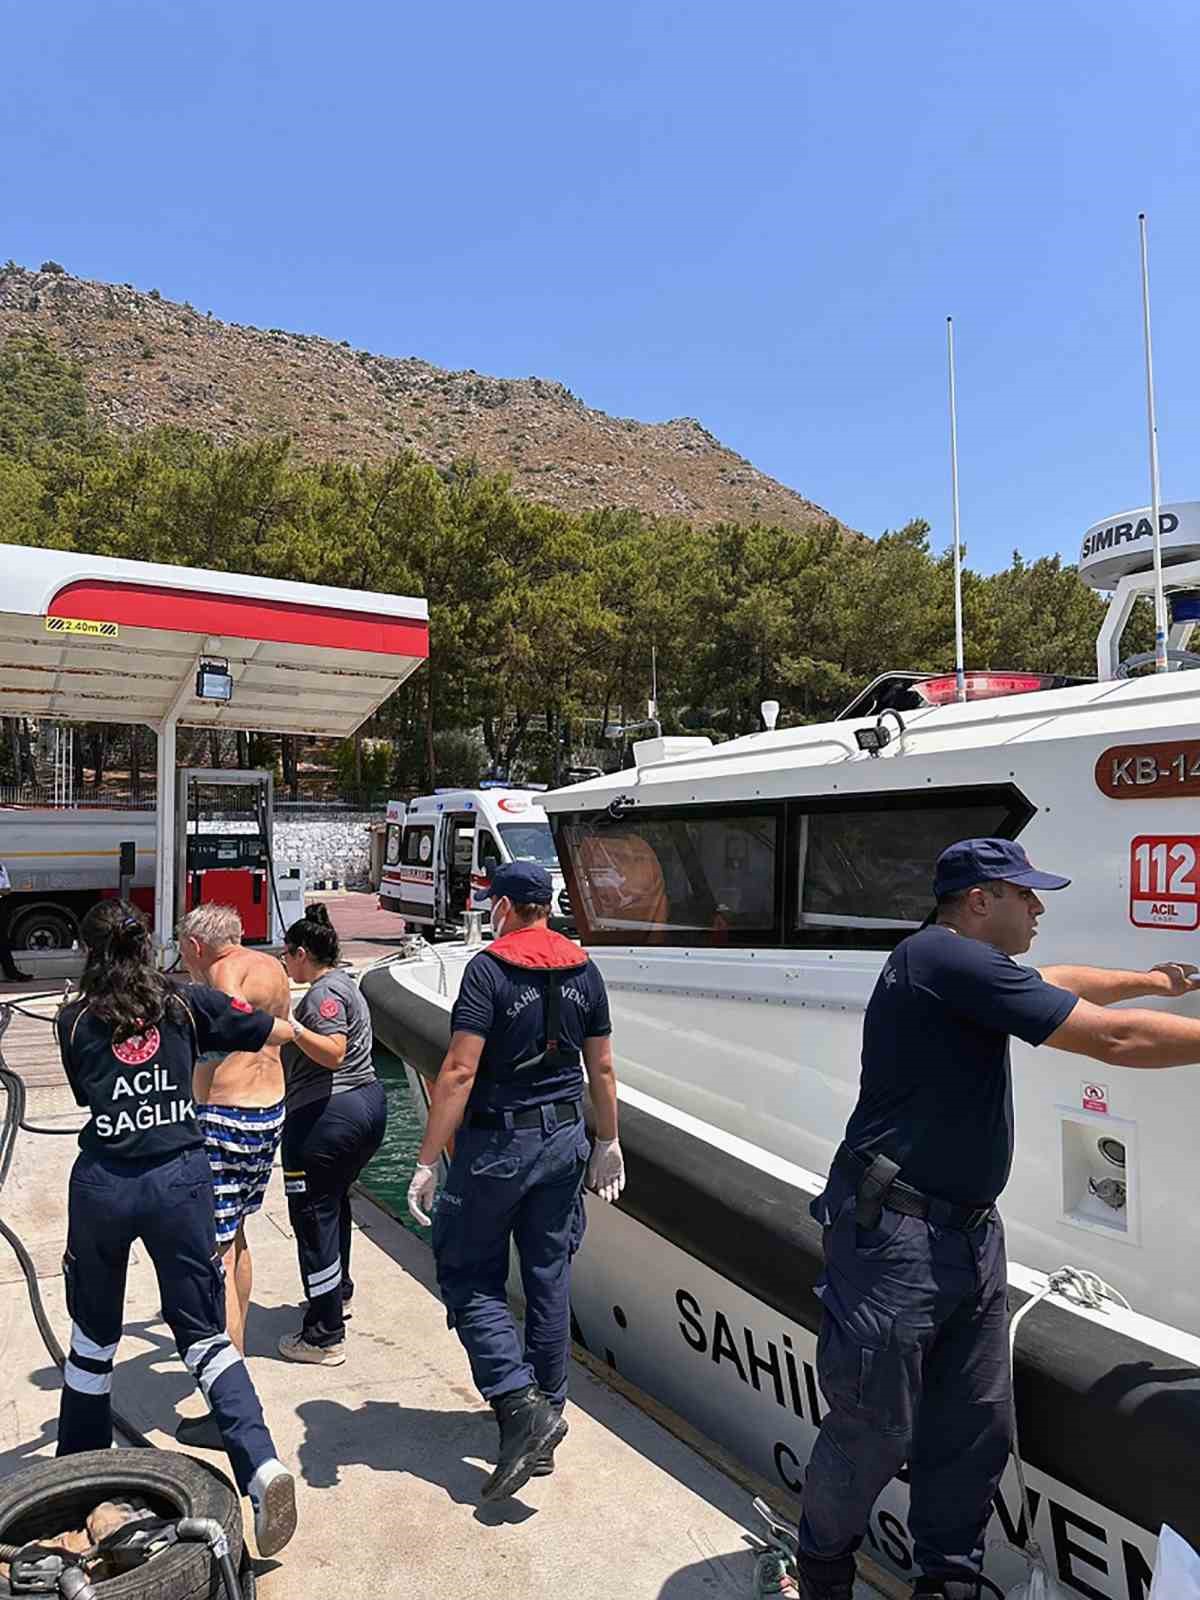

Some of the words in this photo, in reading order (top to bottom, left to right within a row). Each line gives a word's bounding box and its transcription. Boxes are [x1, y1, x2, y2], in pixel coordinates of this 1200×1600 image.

[1082, 513, 1179, 558] SIMRAD
[1135, 842, 1196, 895] 112
[112, 1063, 178, 1101] ACİL
[95, 1099, 196, 1137] SAĞLIK
